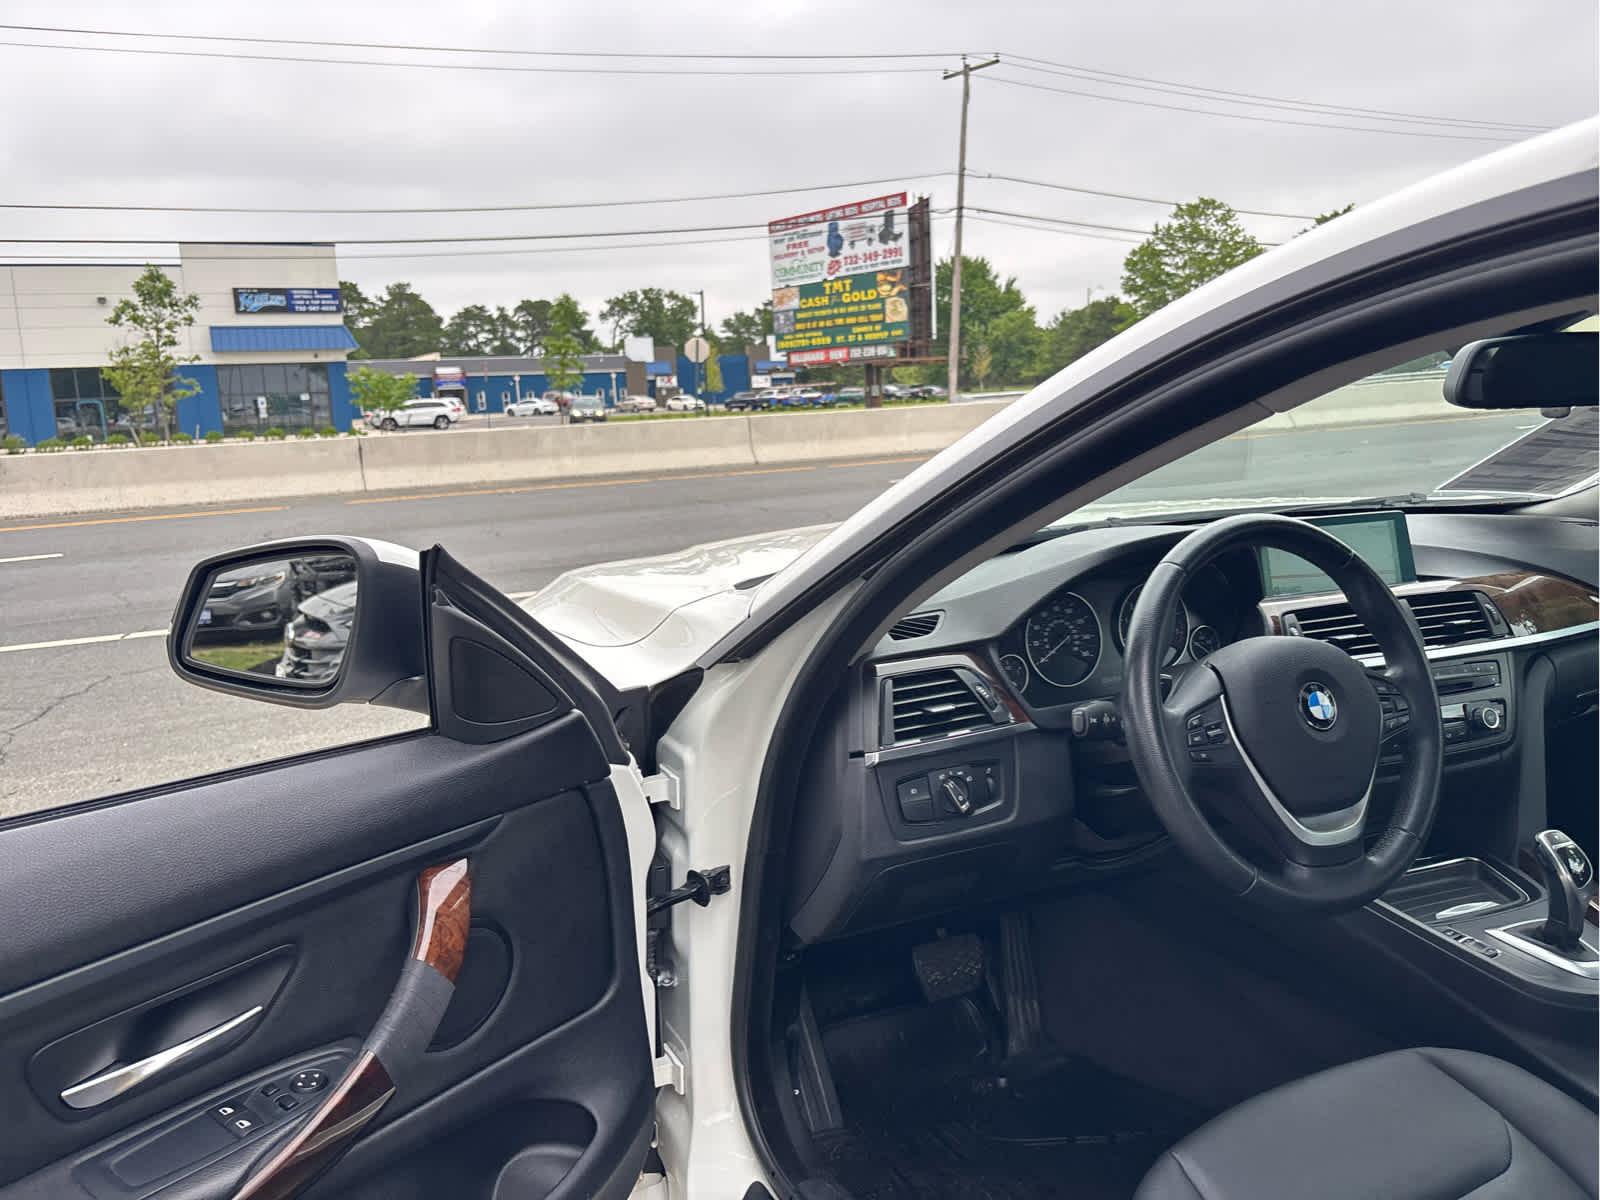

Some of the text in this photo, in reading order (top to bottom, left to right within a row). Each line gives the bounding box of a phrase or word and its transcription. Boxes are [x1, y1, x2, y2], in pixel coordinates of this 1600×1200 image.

[786, 240, 808, 250] FREE
[822, 279, 853, 295] TMT
[800, 296, 829, 309] CASH
[841, 289, 877, 303] GOLD
